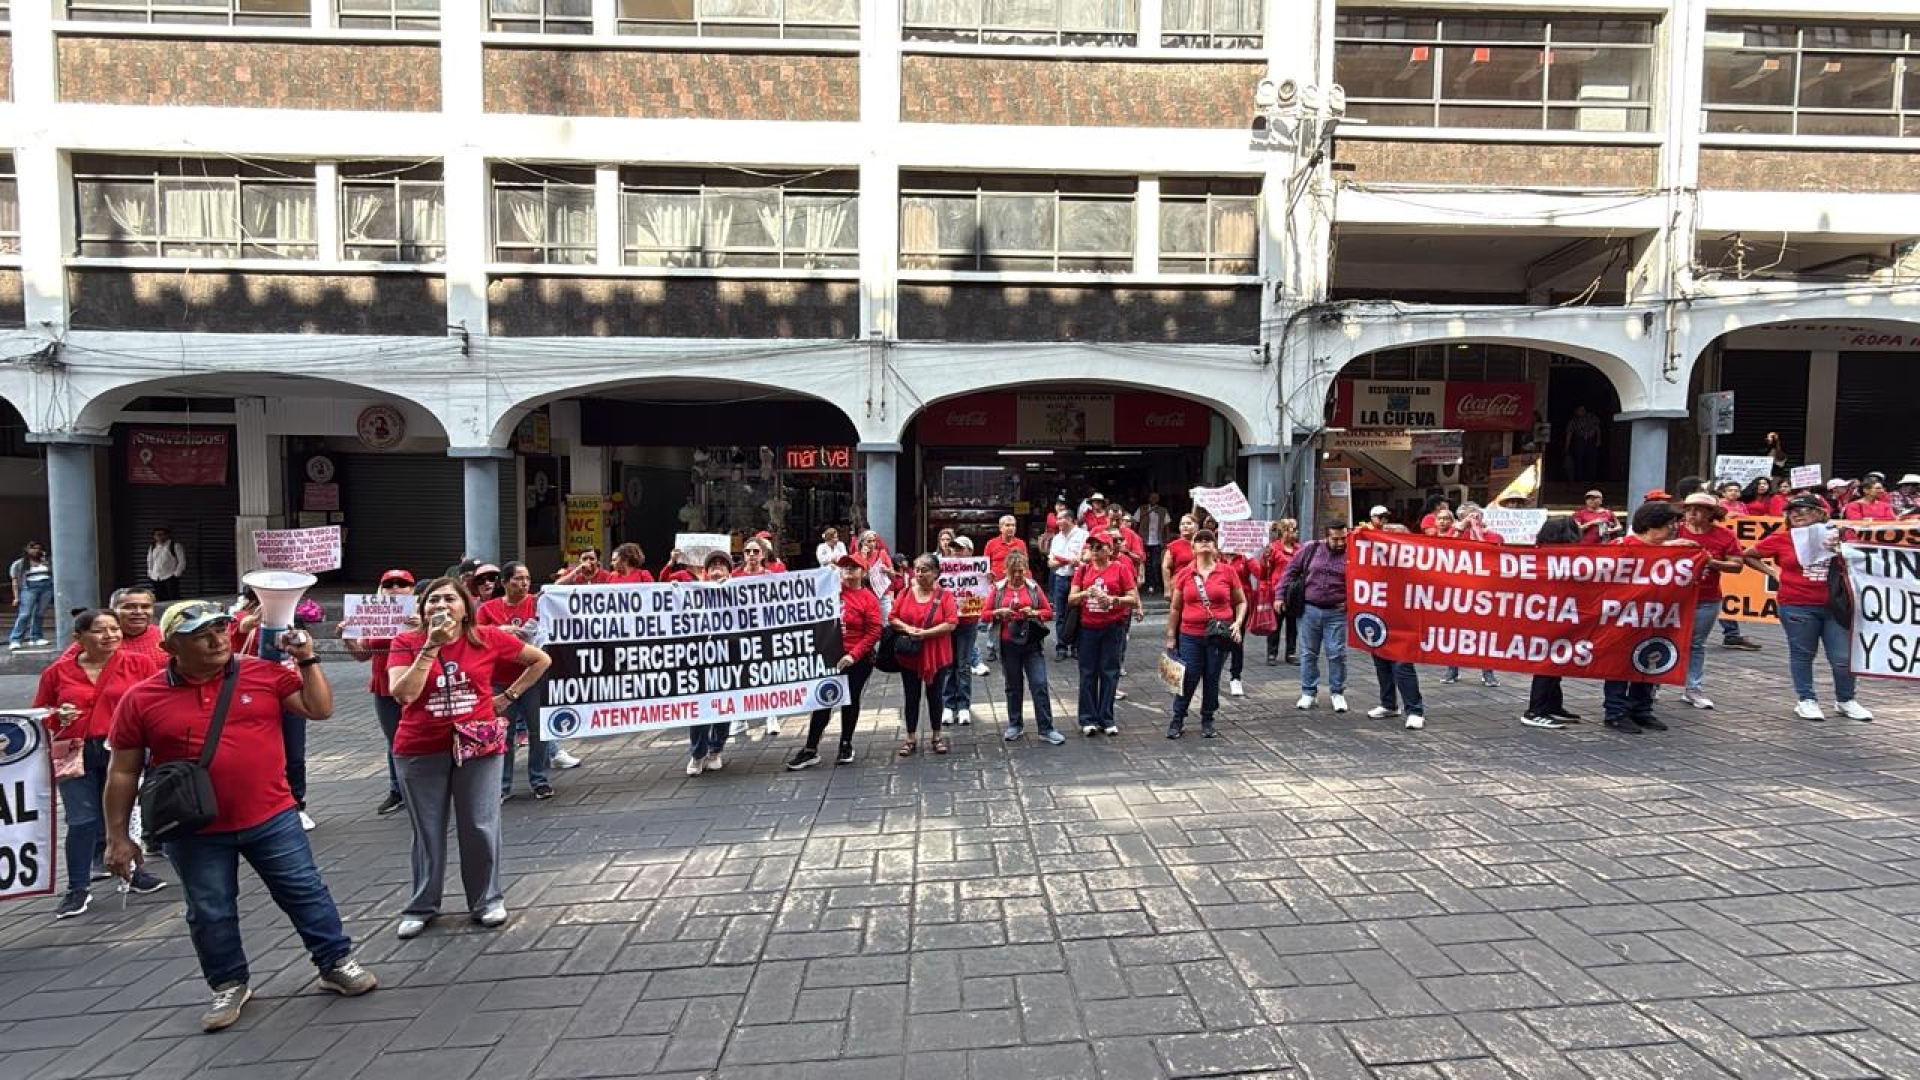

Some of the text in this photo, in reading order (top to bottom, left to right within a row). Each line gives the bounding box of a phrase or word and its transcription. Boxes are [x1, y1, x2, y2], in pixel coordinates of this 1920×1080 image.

[1850, 335, 1902, 346] ROPA
[1415, 386, 1431, 396] BAR
[1361, 411, 1436, 426] LA CUEVA
[569, 518, 595, 531] WC
[939, 576, 979, 588] es una
[1355, 540, 1491, 577] TRIBUNAL
[1499, 553, 1537, 579] DE
[1547, 555, 1694, 586] MORELOS
[569, 573, 817, 615] ÓRGANO DE ADMINISTRACIÓN
[1353, 579, 1681, 628] DE INJUSTICIA PARA
[549, 598, 835, 641] JUDICIAL DEL ESTADO DE MORELOS
[576, 629, 815, 674] TU PERCEPCIÓN DE ESTE
[1420, 626, 1594, 667] JUBILADOS
[1859, 632, 1879, 670] Y
[548, 671, 672, 706] MOVIMIENTO
[677, 668, 700, 695] ES
[704, 664, 744, 692] MUY
[590, 701, 699, 729] ATENTAMENTE
